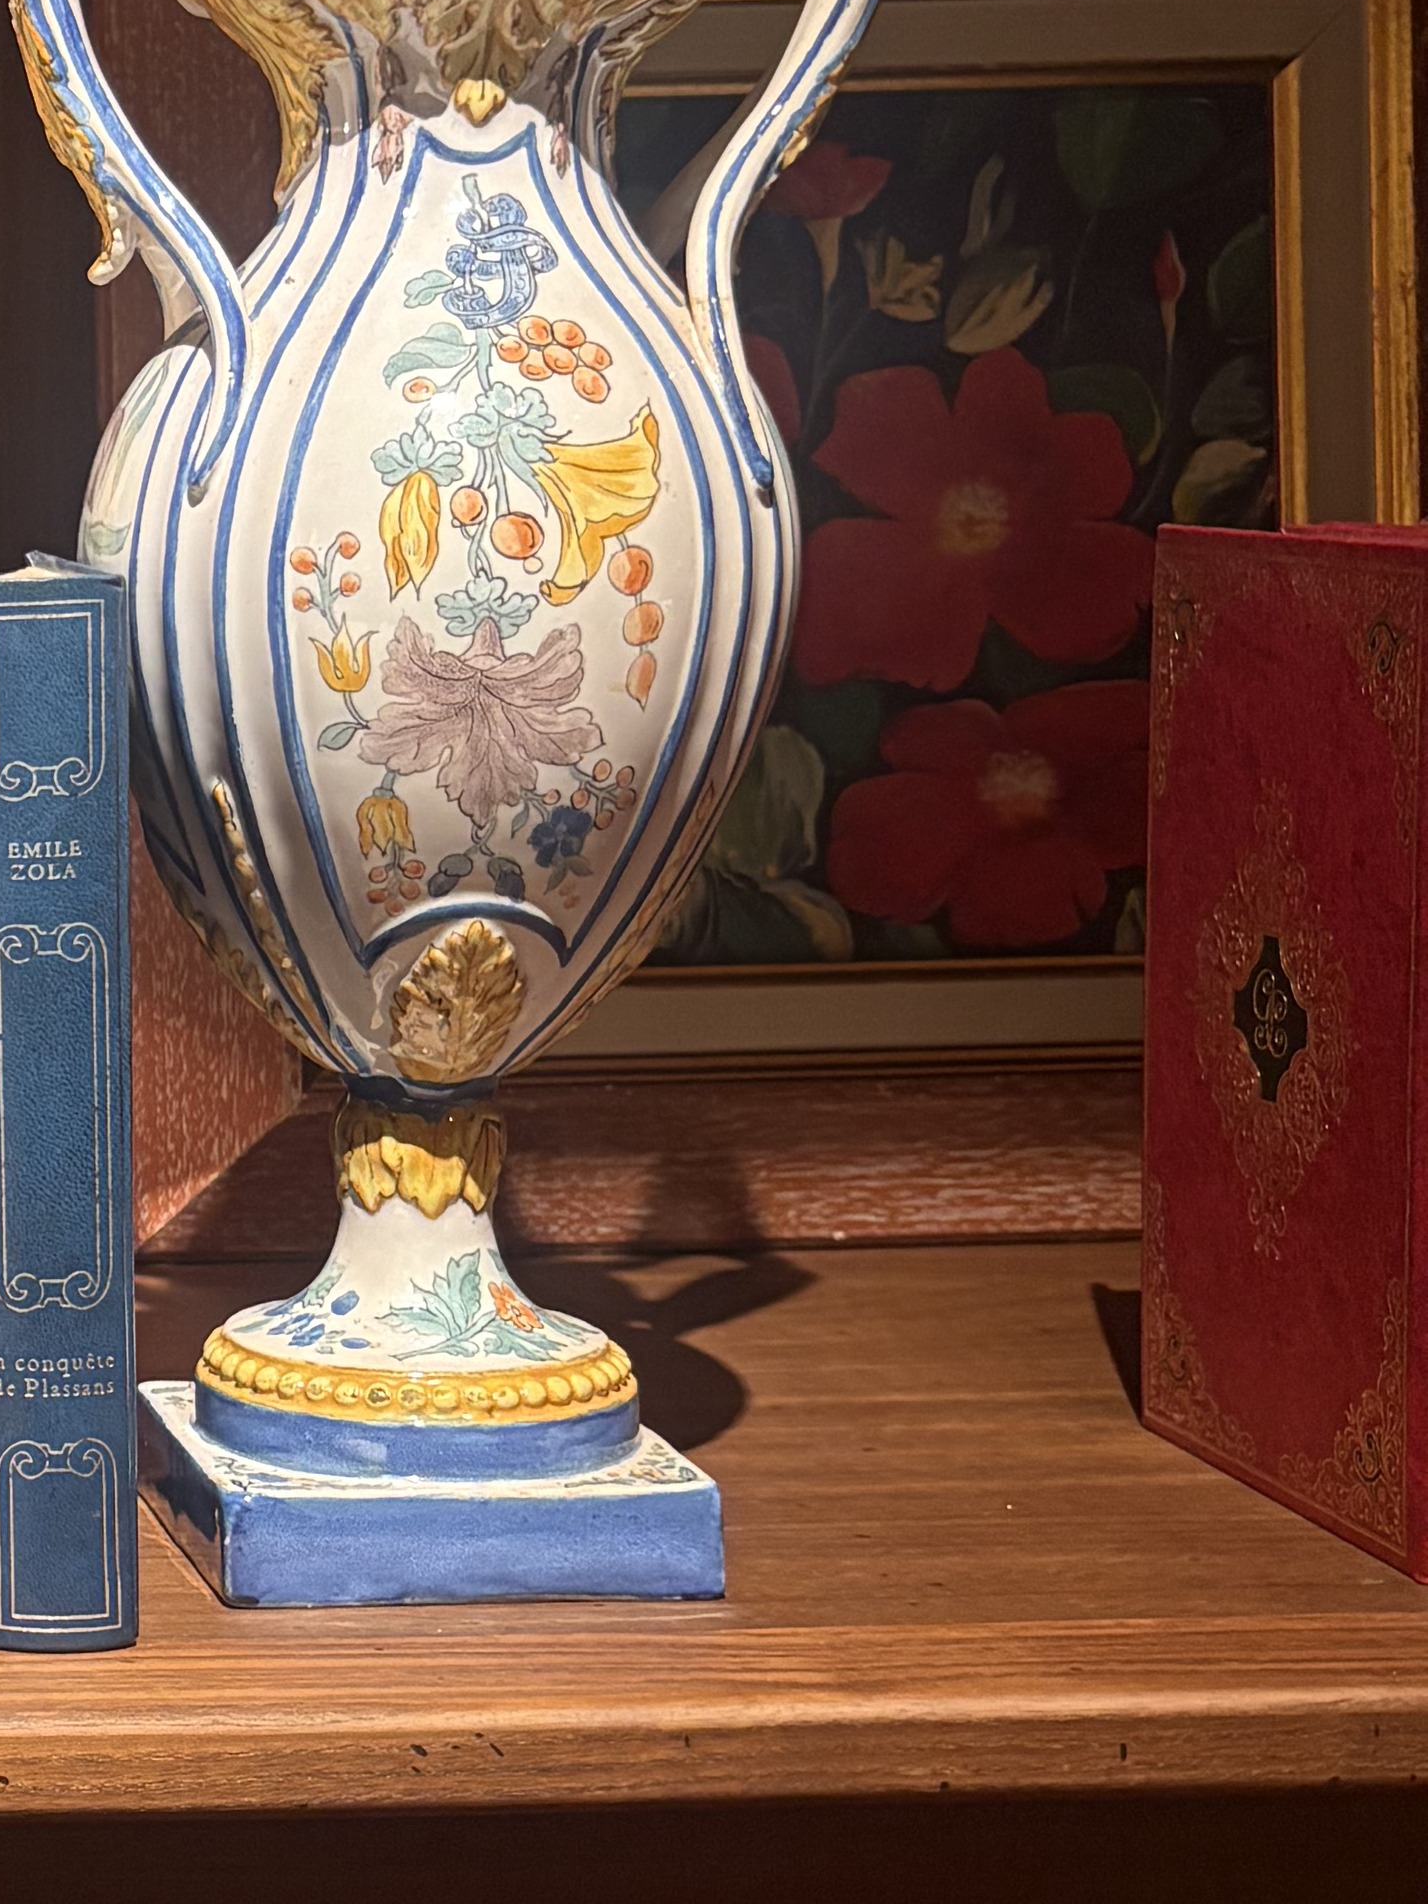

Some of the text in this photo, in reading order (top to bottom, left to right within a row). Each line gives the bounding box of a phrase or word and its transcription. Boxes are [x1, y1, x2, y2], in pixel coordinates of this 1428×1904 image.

[7, 840, 82, 859] EMILE
[9, 863, 78, 881] ZOLA
[14, 1351, 115, 1379] conquête
[23, 1376, 115, 1398] Plassans
